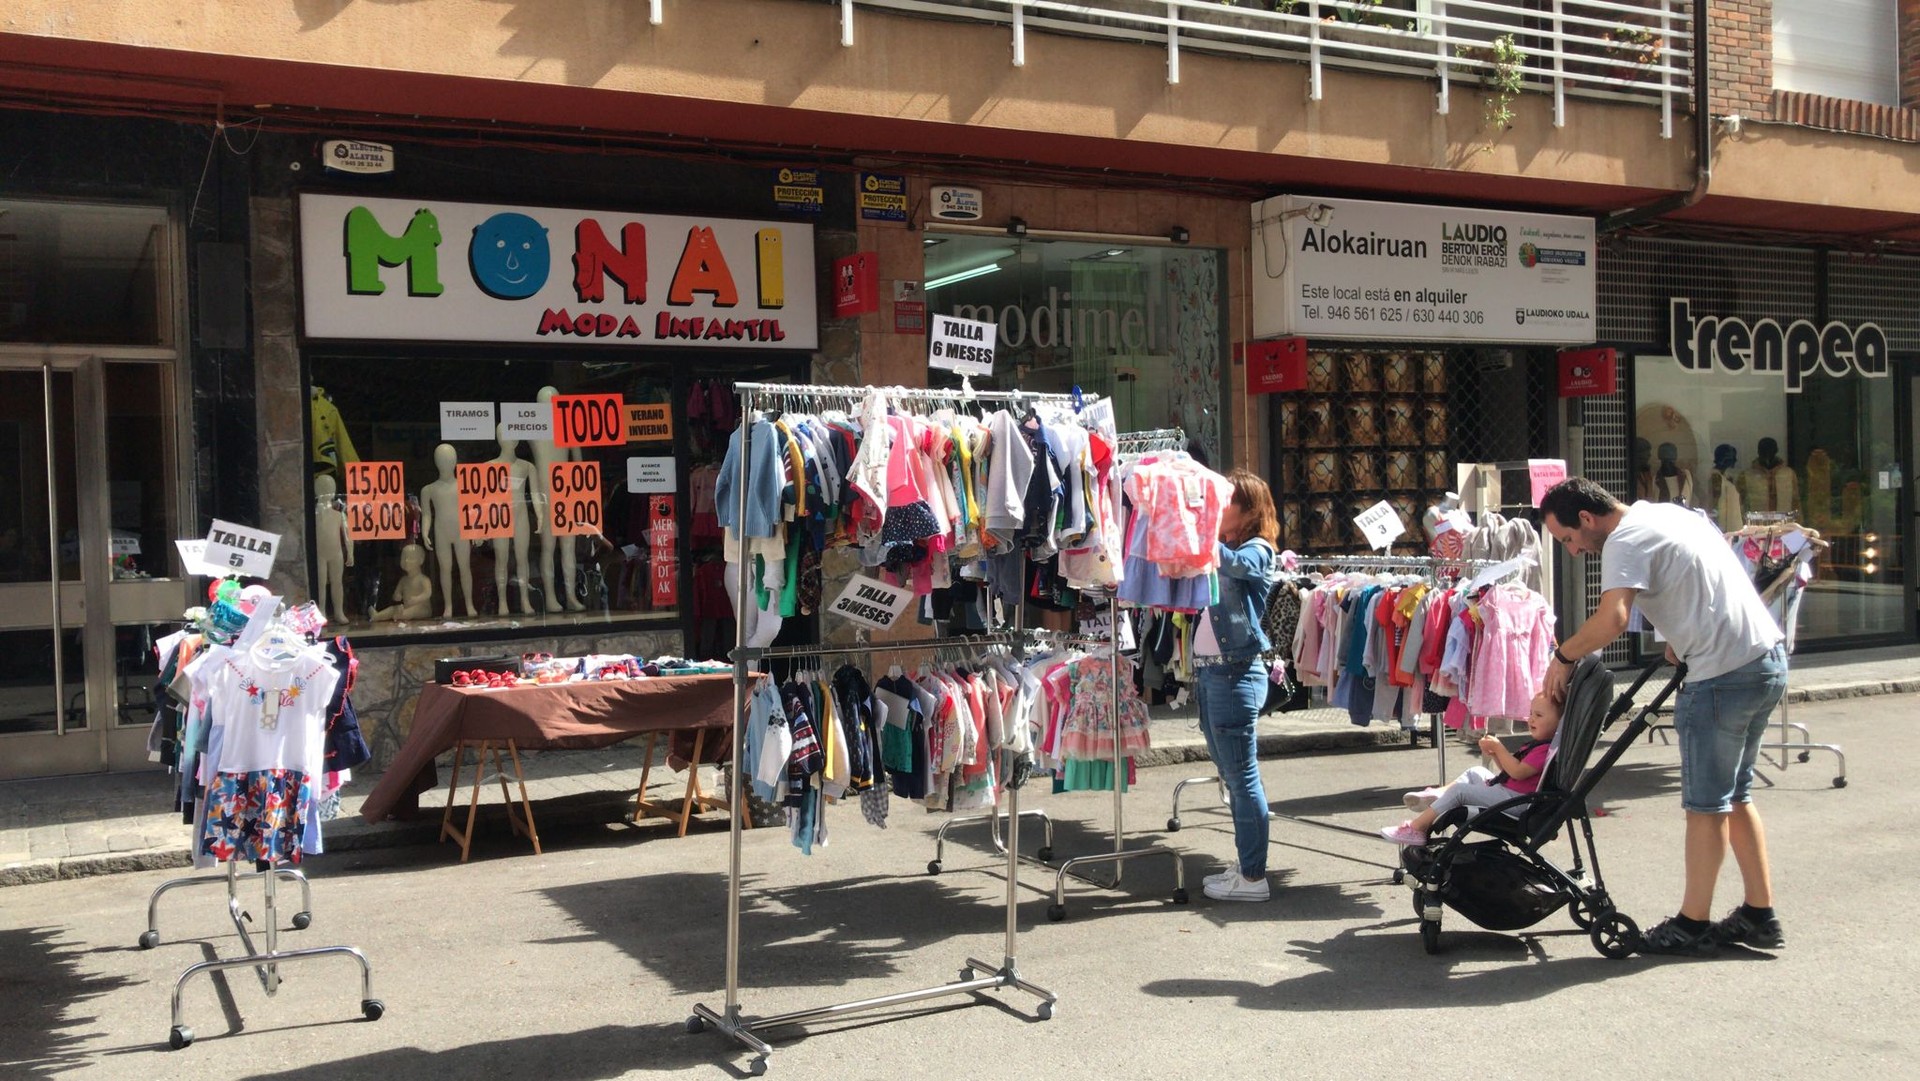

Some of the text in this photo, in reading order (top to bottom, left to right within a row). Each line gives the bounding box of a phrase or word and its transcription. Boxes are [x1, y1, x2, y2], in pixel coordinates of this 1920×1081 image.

[777, 187, 820, 197] PROTECCIÓN
[864, 195, 904, 204] PROTECCIÓN
[1301, 227, 1427, 258] Alokairuan
[1442, 222, 1508, 244] LAUDIO
[343, 205, 784, 310] MONAI
[1442, 242, 1508, 257] BERTON EROSI
[1442, 255, 1508, 268] DENOK IRABAZI
[1302, 284, 1467, 306] Este local está en alquiler
[1302, 305, 1323, 319] Tel.
[1328, 306, 1350, 320] 946
[1354, 307, 1375, 321] 561
[1380, 308, 1402, 322] 625
[1413, 309, 1435, 323] 630
[1438, 310, 1460, 323] 440
[1463, 311, 1484, 324] 306
[1526, 308, 1590, 319] LAUDIOKO UDALA
[536, 307, 785, 342] MODA INFANTIL
[943, 320, 983, 341] TALLA
[932, 340, 993, 364] 6 MESES
[1670, 297, 1888, 393] trenpea
[518, 410, 536, 418] LOS
[556, 398, 620, 444] TODO
[631, 409, 664, 421] VERANO
[507, 423, 548, 431] PRECIOS
[629, 424, 668, 437] INVIERNO
[349, 465, 400, 500] 15,00
[460, 466, 508, 499] 10,00
[552, 465, 597, 497] 6,00
[351, 502, 401, 537] 18,00
[463, 503, 511, 535] 12,00
[554, 501, 599, 533] 8,00
[652, 519, 673, 531] MER
[1359, 506, 1389, 528] TALLA
[1378, 524, 1387, 534] 3
[213, 529, 272, 556] TALLA
[657, 534, 668, 547] KE
[229, 552, 244, 568] 5
[657, 550, 668, 562] AL
[658, 565, 669, 578] DI
[658, 581, 671, 593] AK
[856, 583, 897, 607] TALLA
